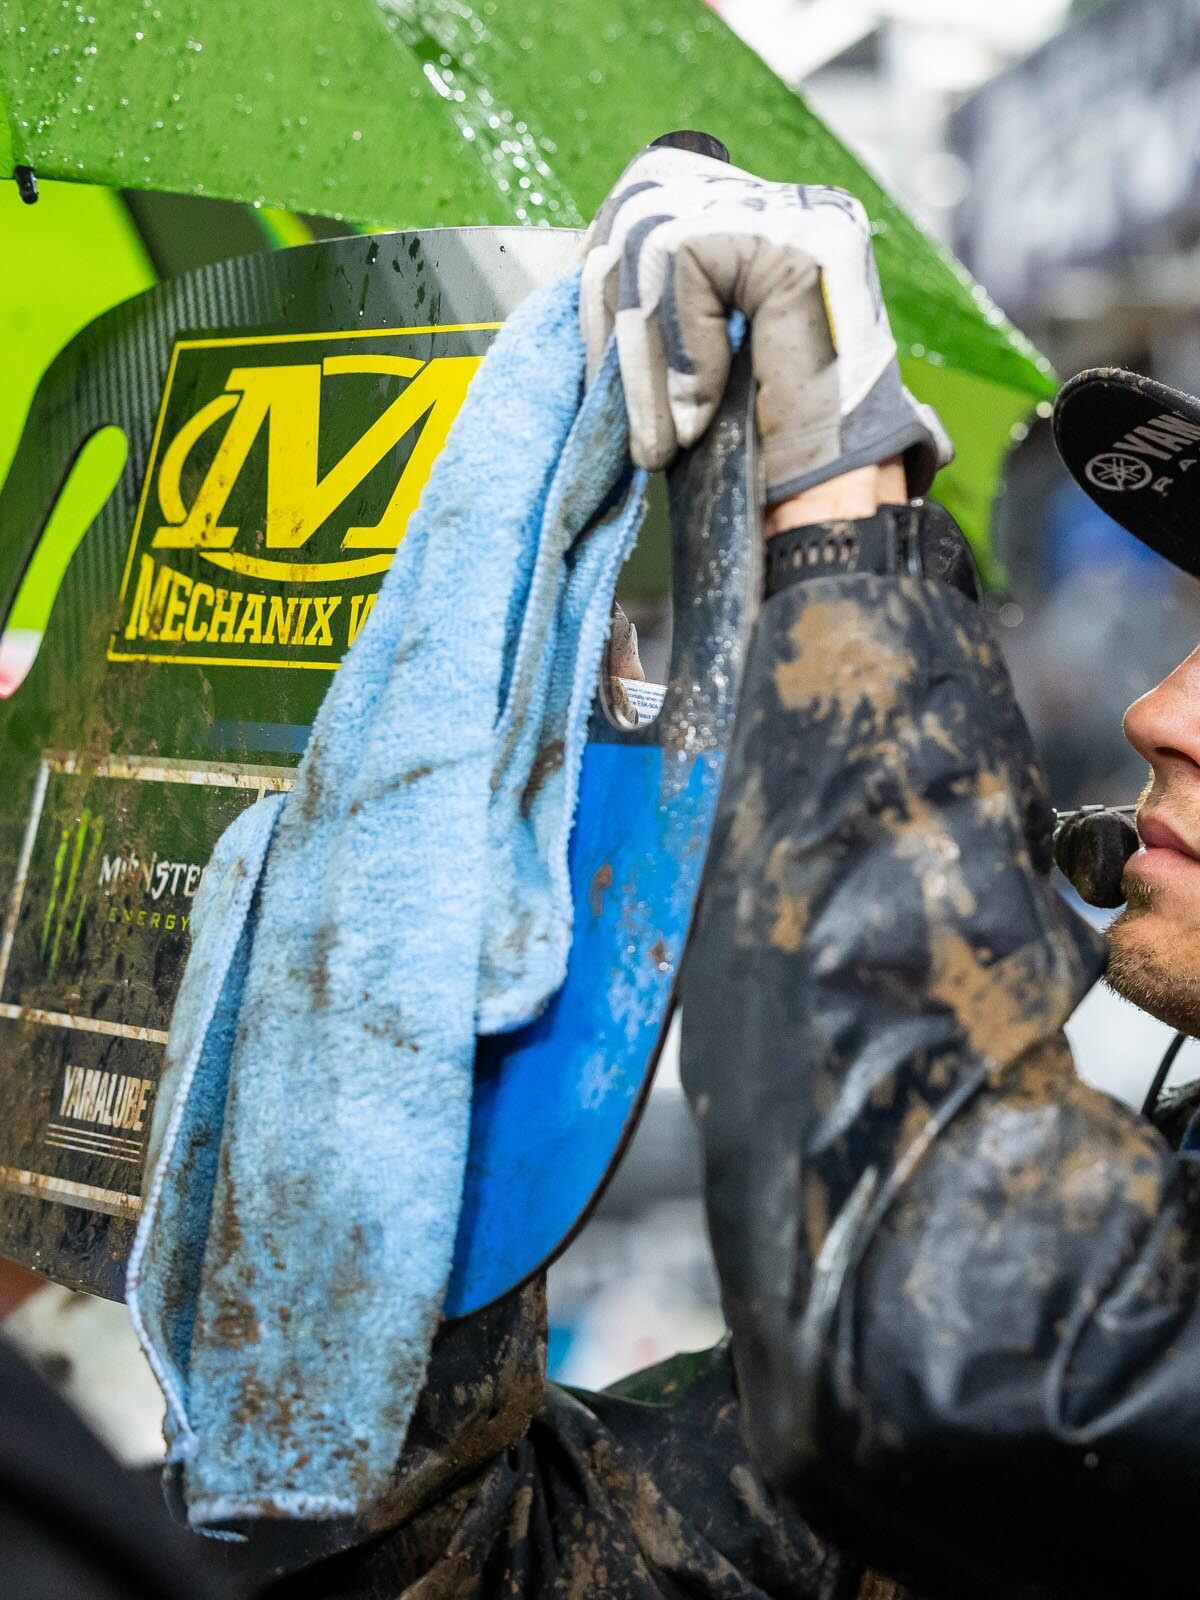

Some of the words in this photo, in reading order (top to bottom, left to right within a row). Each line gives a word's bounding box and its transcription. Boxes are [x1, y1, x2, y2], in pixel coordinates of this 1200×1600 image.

[124, 552, 343, 647] MECHANIX
[108, 907, 190, 932] ENERGY
[60, 1065, 153, 1132] YAMALUBE
